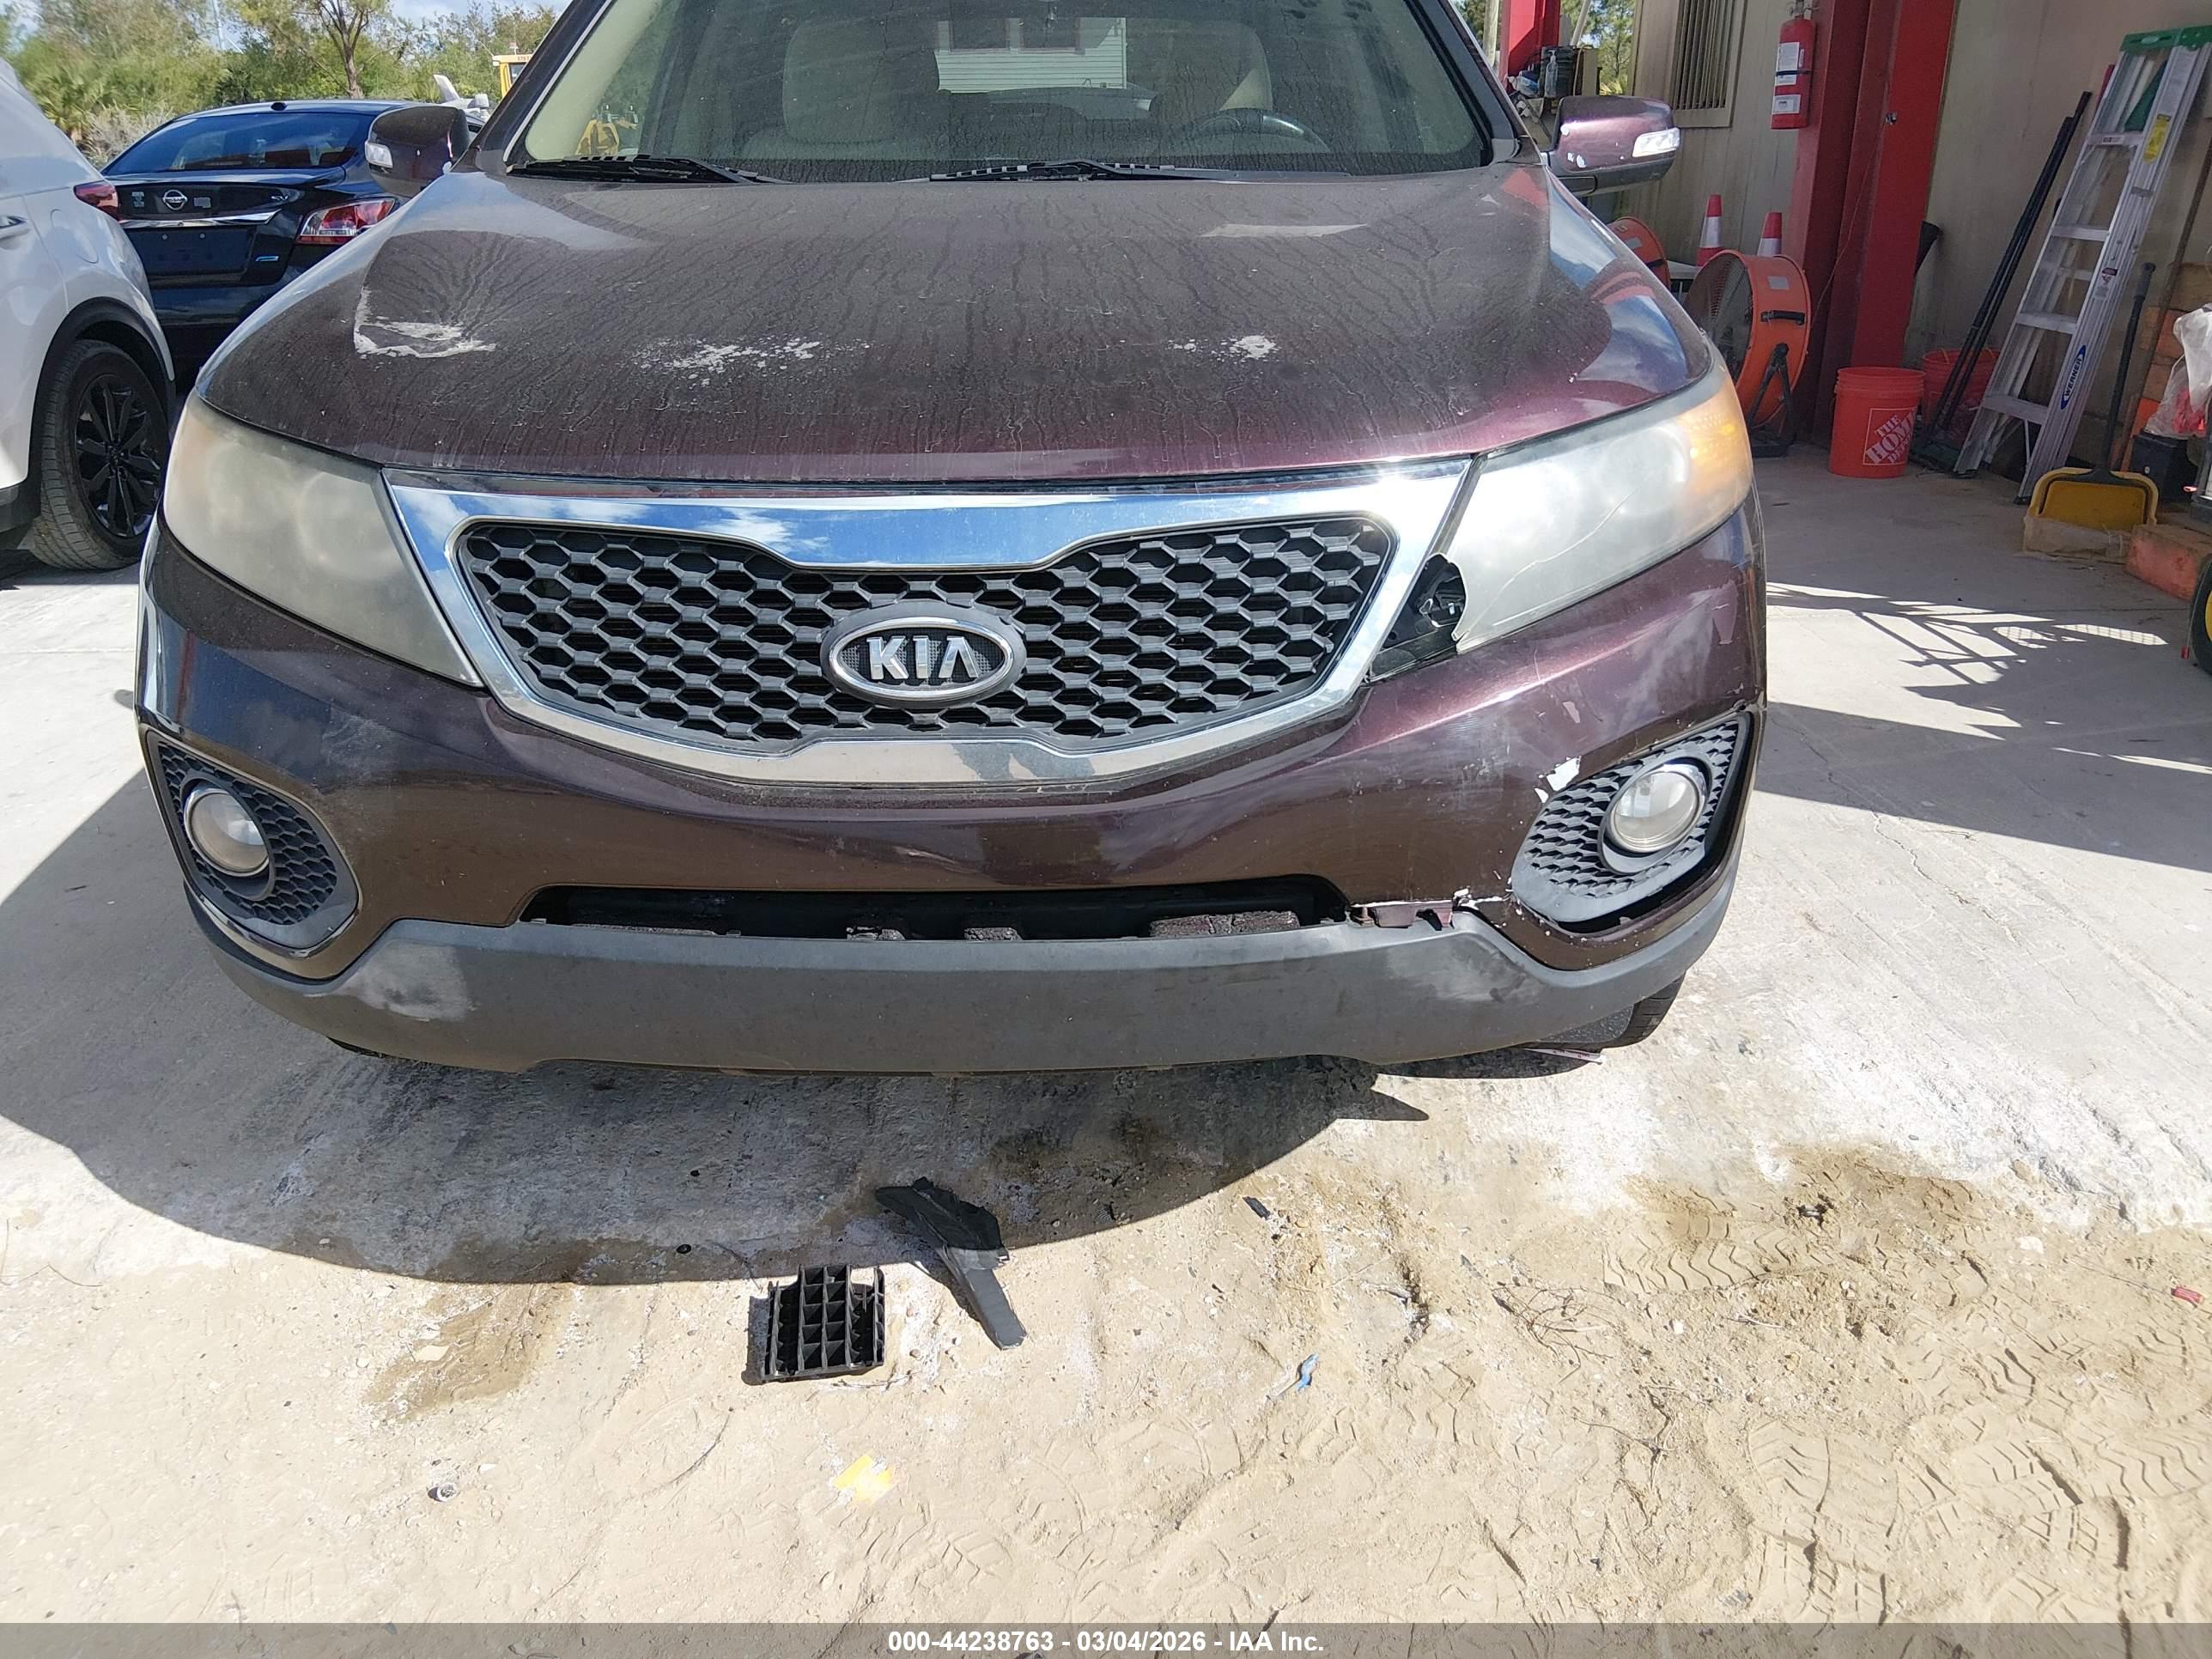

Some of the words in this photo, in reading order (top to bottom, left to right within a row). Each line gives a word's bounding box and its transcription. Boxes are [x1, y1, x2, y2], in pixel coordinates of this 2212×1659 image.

[2065, 357, 2082, 397] WERNER
[1875, 414, 1900, 437] THE
[866, 635, 979, 680] KIA
